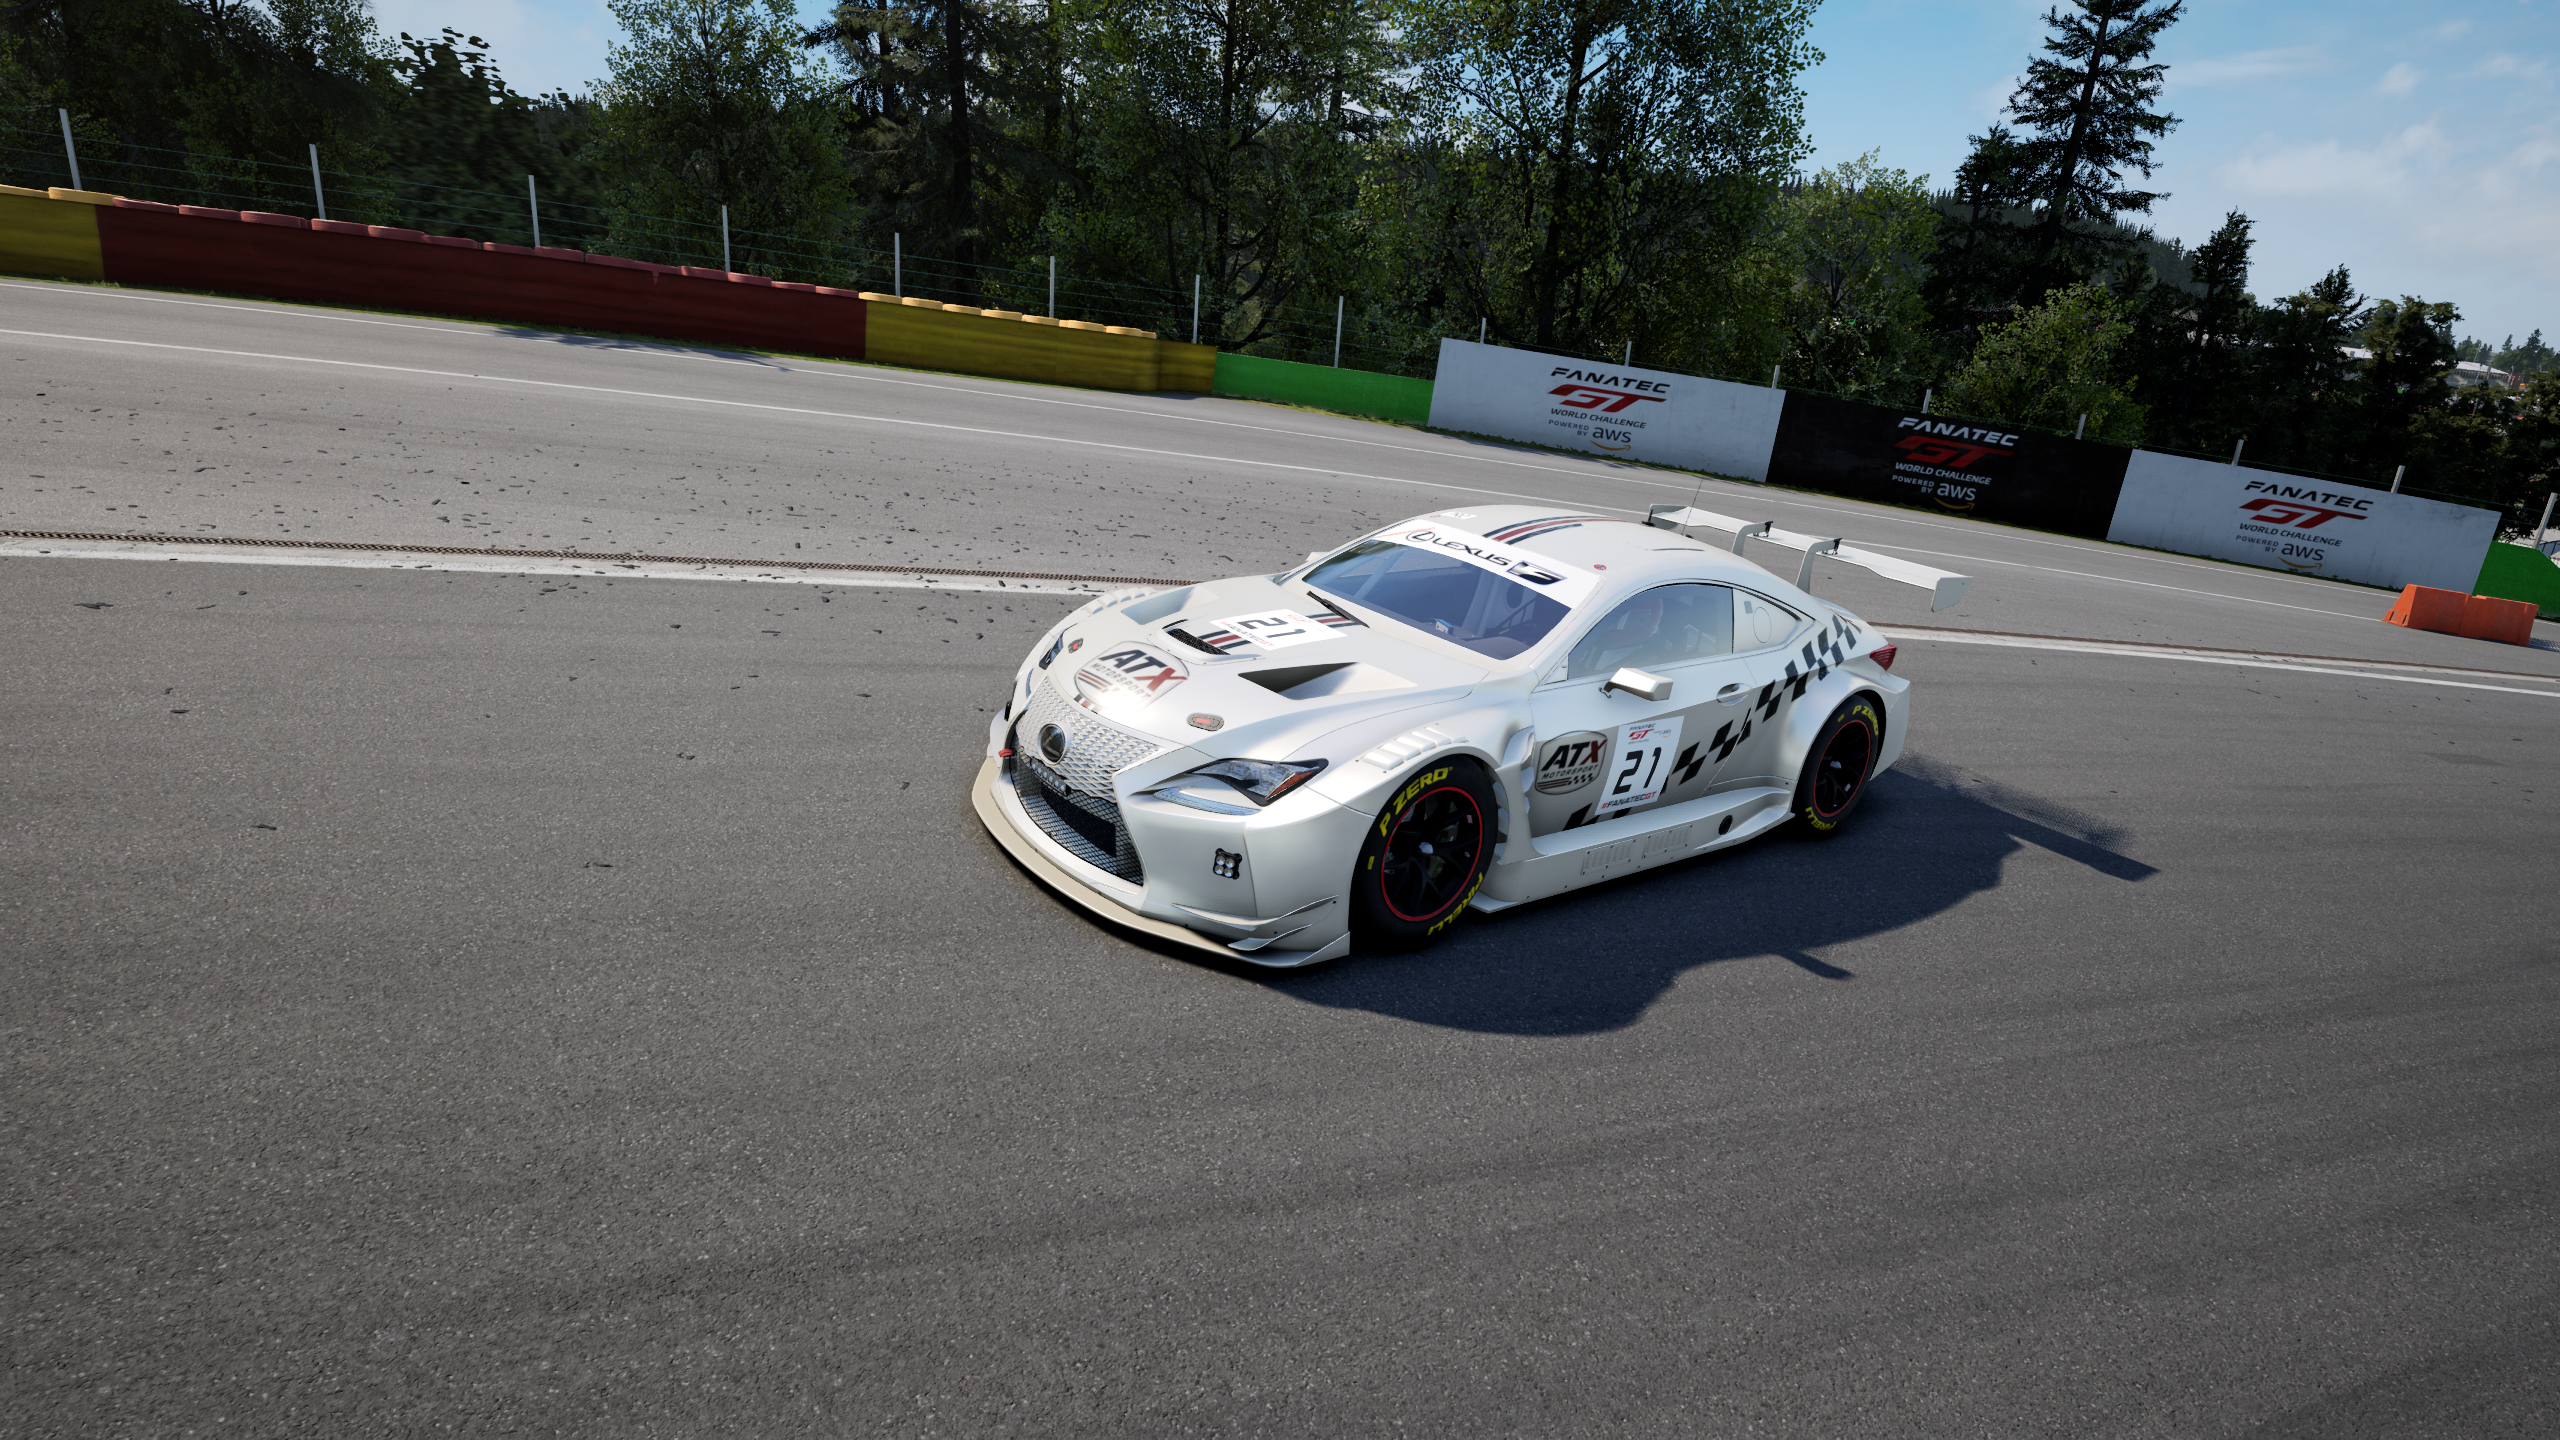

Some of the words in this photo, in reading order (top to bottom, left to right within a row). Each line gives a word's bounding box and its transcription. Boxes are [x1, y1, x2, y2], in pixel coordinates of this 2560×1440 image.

[1550, 367, 1671, 393] FANATEC
[1548, 384, 1667, 413] GT
[1548, 419, 1589, 431] POWERED
[1551, 408, 1588, 420] WORLD
[1589, 414, 1647, 429] CHALLENGE
[1592, 426, 1632, 443] aws
[1898, 417, 2019, 447] FANATEC
[1893, 435, 2015, 468] GT
[1892, 474, 1935, 488] POWERED
[1895, 462, 1934, 475] WORLD
[1935, 469, 1992, 485] CHALLENGE
[1921, 486, 1933, 494] BY
[1937, 482, 1977, 501] aws
[2244, 480, 2374, 511] FANATEC
[2239, 498, 2369, 529] GT
[2235, 535, 2279, 547] POWERED
[2239, 522, 2279, 535] WORLD
[2280, 529, 2343, 547] CHALLENGE
[1432, 537, 1512, 566] LEXUS
[2281, 542, 2325, 561] aws
[1236, 617, 1307, 638] 21
[1090, 662, 1151, 699] MOTORSPORT
[1098, 649, 1188, 692] ATX
[1852, 705, 1862, 715] P
[1861, 705, 1879, 736] ZERO
[1540, 739, 1609, 772] ATX
[1542, 764, 1599, 780] MOTORSPORT
[1612, 746, 1662, 796] 21
[1379, 812, 1391, 837] P
[1393, 767, 1449, 815] ZERO
[1601, 790, 1658, 809] #FANATECGT
[1427, 872, 1484, 936] PIRELLI
